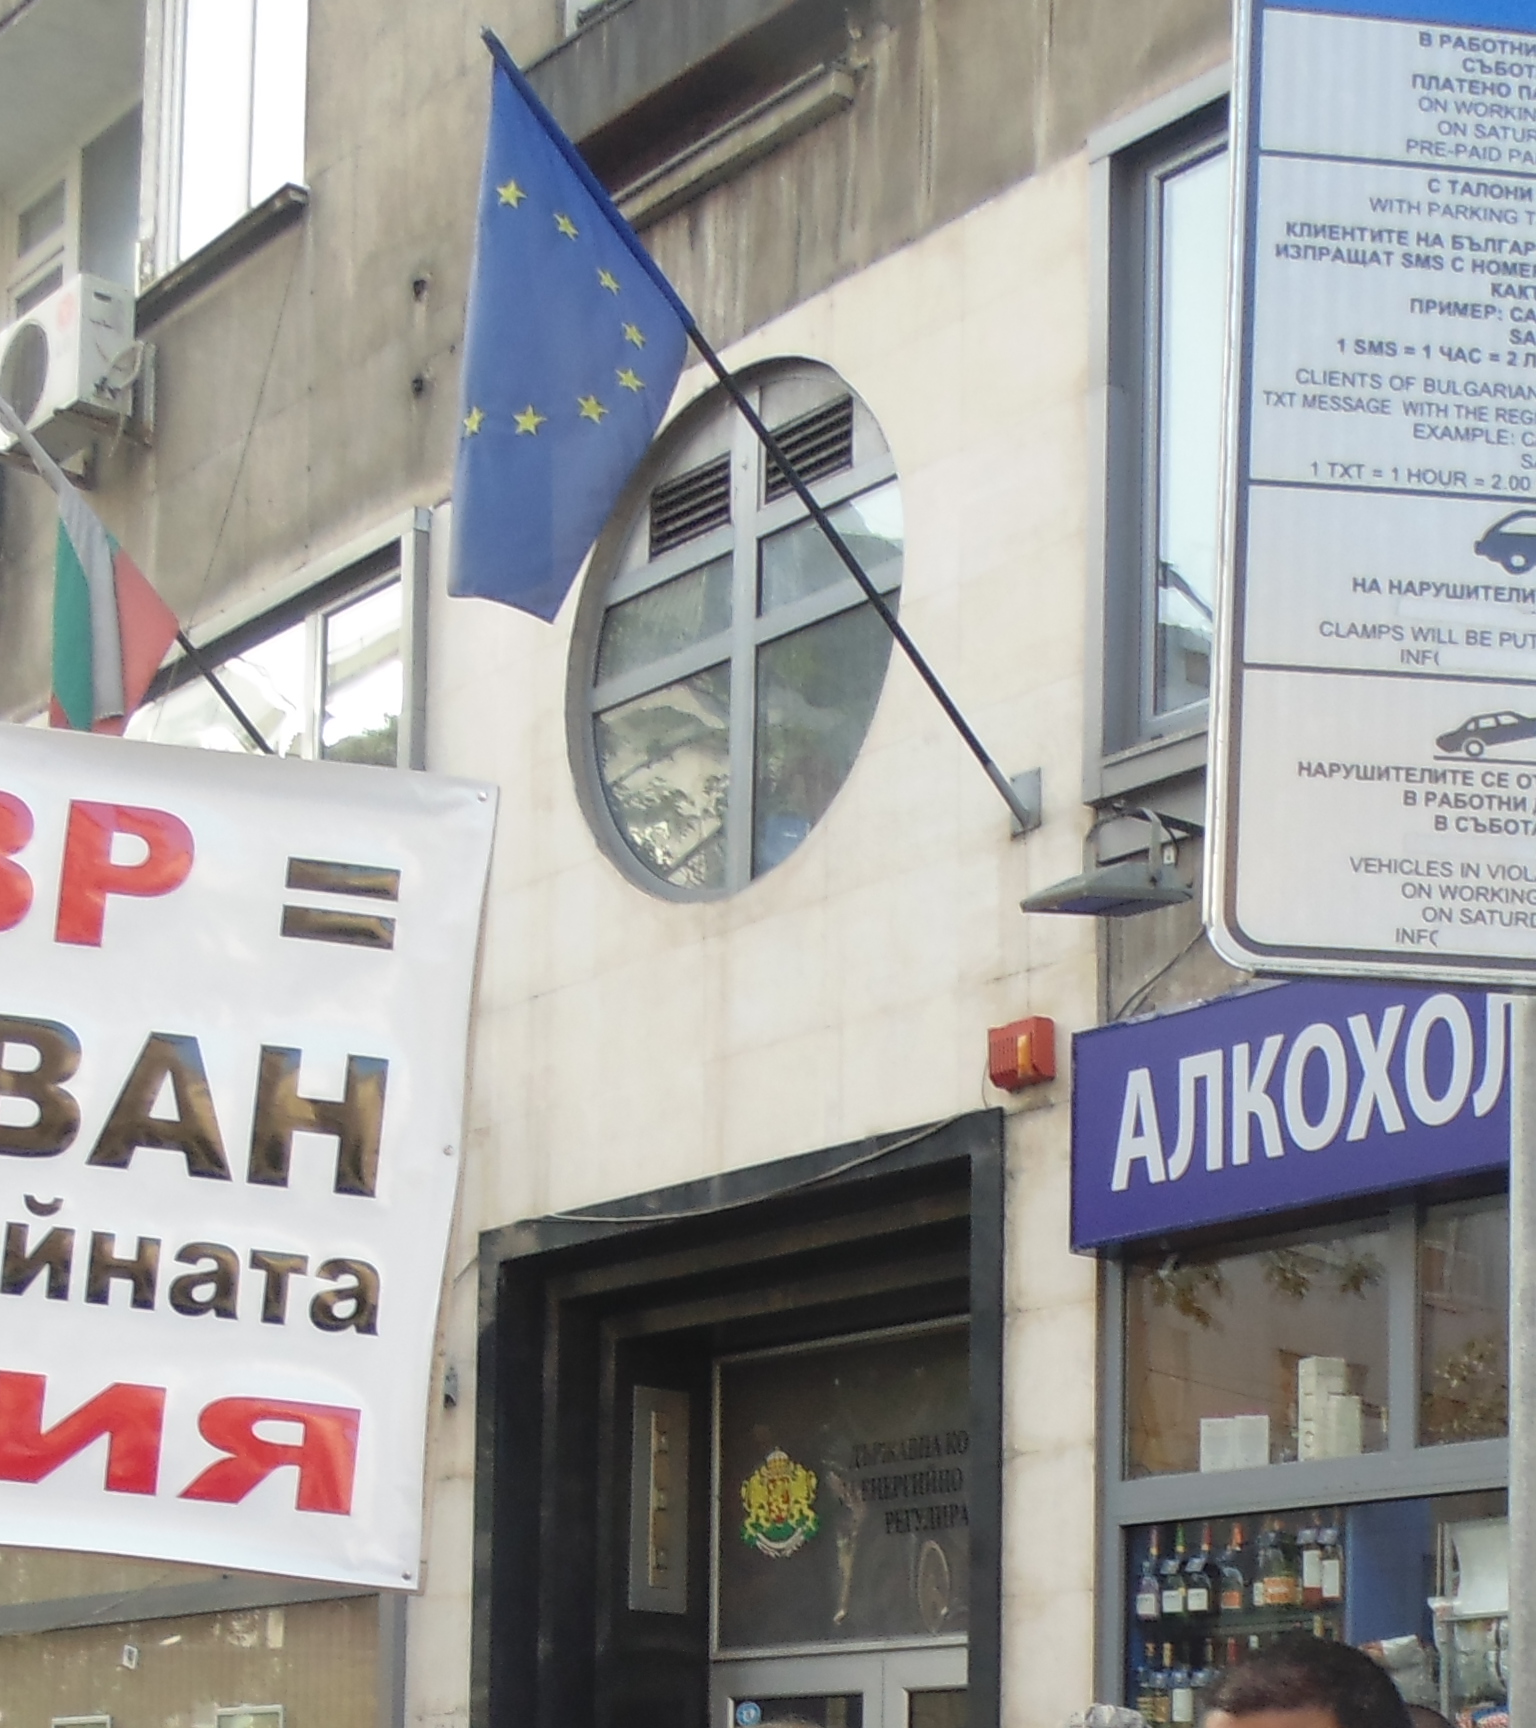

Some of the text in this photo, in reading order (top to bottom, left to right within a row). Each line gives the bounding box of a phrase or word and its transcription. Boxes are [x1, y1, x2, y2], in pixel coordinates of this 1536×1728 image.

[1411, 72, 1513, 99] ПЛАТЕНО
[1405, 137, 1503, 163] PRE-PAID
[1426, 177, 1441, 194] С
[1447, 178, 1533, 203] ТАЛОНИ
[1368, 196, 1422, 216] WITH
[1426, 200, 1519, 226] PARKING
[1285, 220, 1410, 247] КЛИЕНТИТЕ
[1415, 230, 1445, 249] НА
[1274, 242, 1395, 268] ИЗПРАЩАТ
[1400, 251, 1445, 272] SMS
[1450, 255, 1465, 273] С
[1294, 367, 1383, 391] CLIENTS
[1388, 374, 1417, 392] OF
[1352, 576, 1382, 595] НА
[1318, 620, 1405, 642] CLAMPS
[1410, 625, 1460, 646] WILL
[1464, 628, 1493, 648] BE
[1297, 760, 1475, 788] НАРУШИТЕЛИТЕ
[1480, 770, 1510, 790] СЕ
[1349, 855, 1454, 879] VEHICLES
[1459, 861, 1481, 880] IN
[280, 856, 402, 950] =
[1109, 992, 1514, 1193] АЛКОХОЛ
